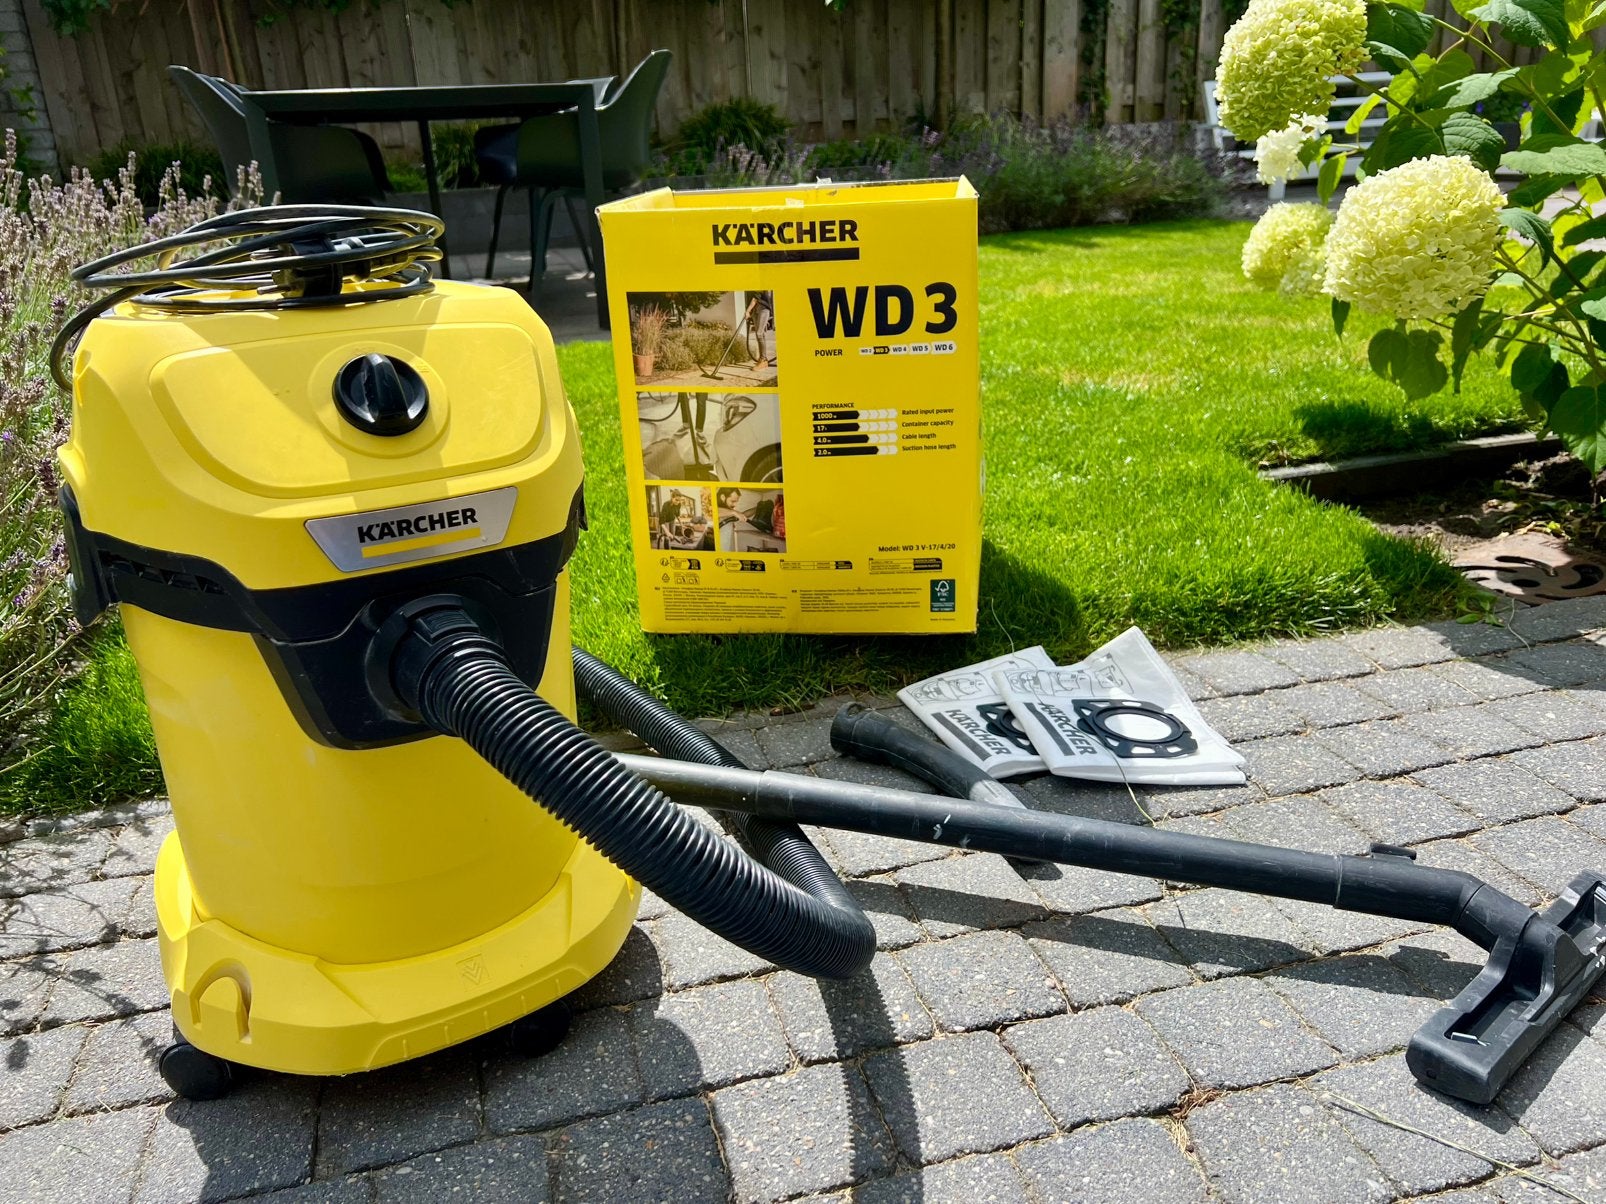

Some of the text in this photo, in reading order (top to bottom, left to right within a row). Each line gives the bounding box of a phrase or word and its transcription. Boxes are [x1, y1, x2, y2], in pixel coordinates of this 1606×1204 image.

[711, 219, 859, 246] KÄRCHER
[807, 281, 958, 339] WD 3
[948, 343, 954, 351] 6
[814, 349, 843, 357] POWER
[935, 407, 955, 415] power
[817, 412, 833, 420] 1000
[930, 419, 954, 427] capacity
[918, 432, 937, 440] length
[938, 443, 957, 451] length
[357, 507, 478, 543] KÄRCHER
[878, 542, 956, 553] Model: WD 3 V-17/4/20
[944, 709, 1013, 755] KÄRCHER
[1038, 702, 1098, 755] KÄRCHER
